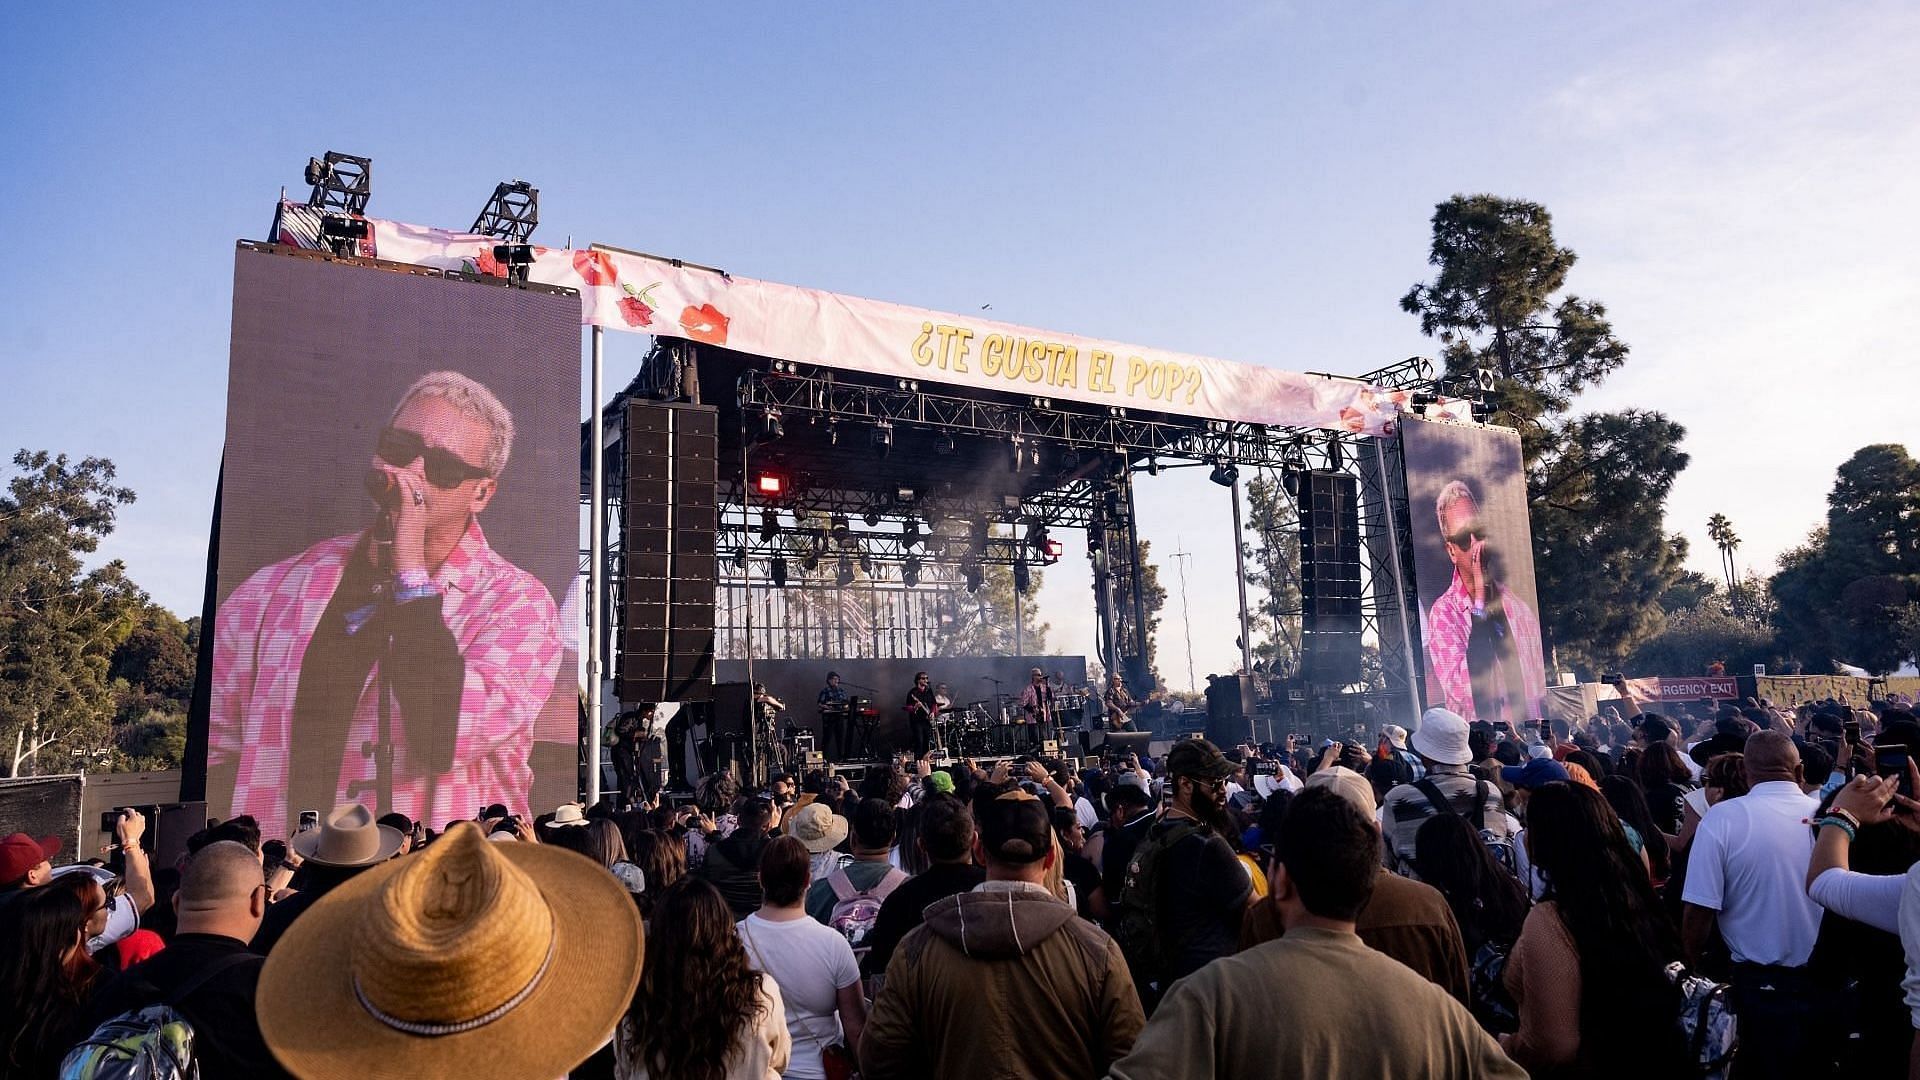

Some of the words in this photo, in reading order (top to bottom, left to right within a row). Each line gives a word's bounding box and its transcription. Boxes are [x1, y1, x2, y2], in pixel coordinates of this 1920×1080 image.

[911, 321, 974, 373] ¿TE
[981, 333, 1078, 389] GUSTA
[1088, 349, 1116, 393] EL
[1126, 355, 1202, 405] POP?
[1644, 684, 1707, 696] EMRGENCY
[1710, 682, 1733, 694] EXIT
